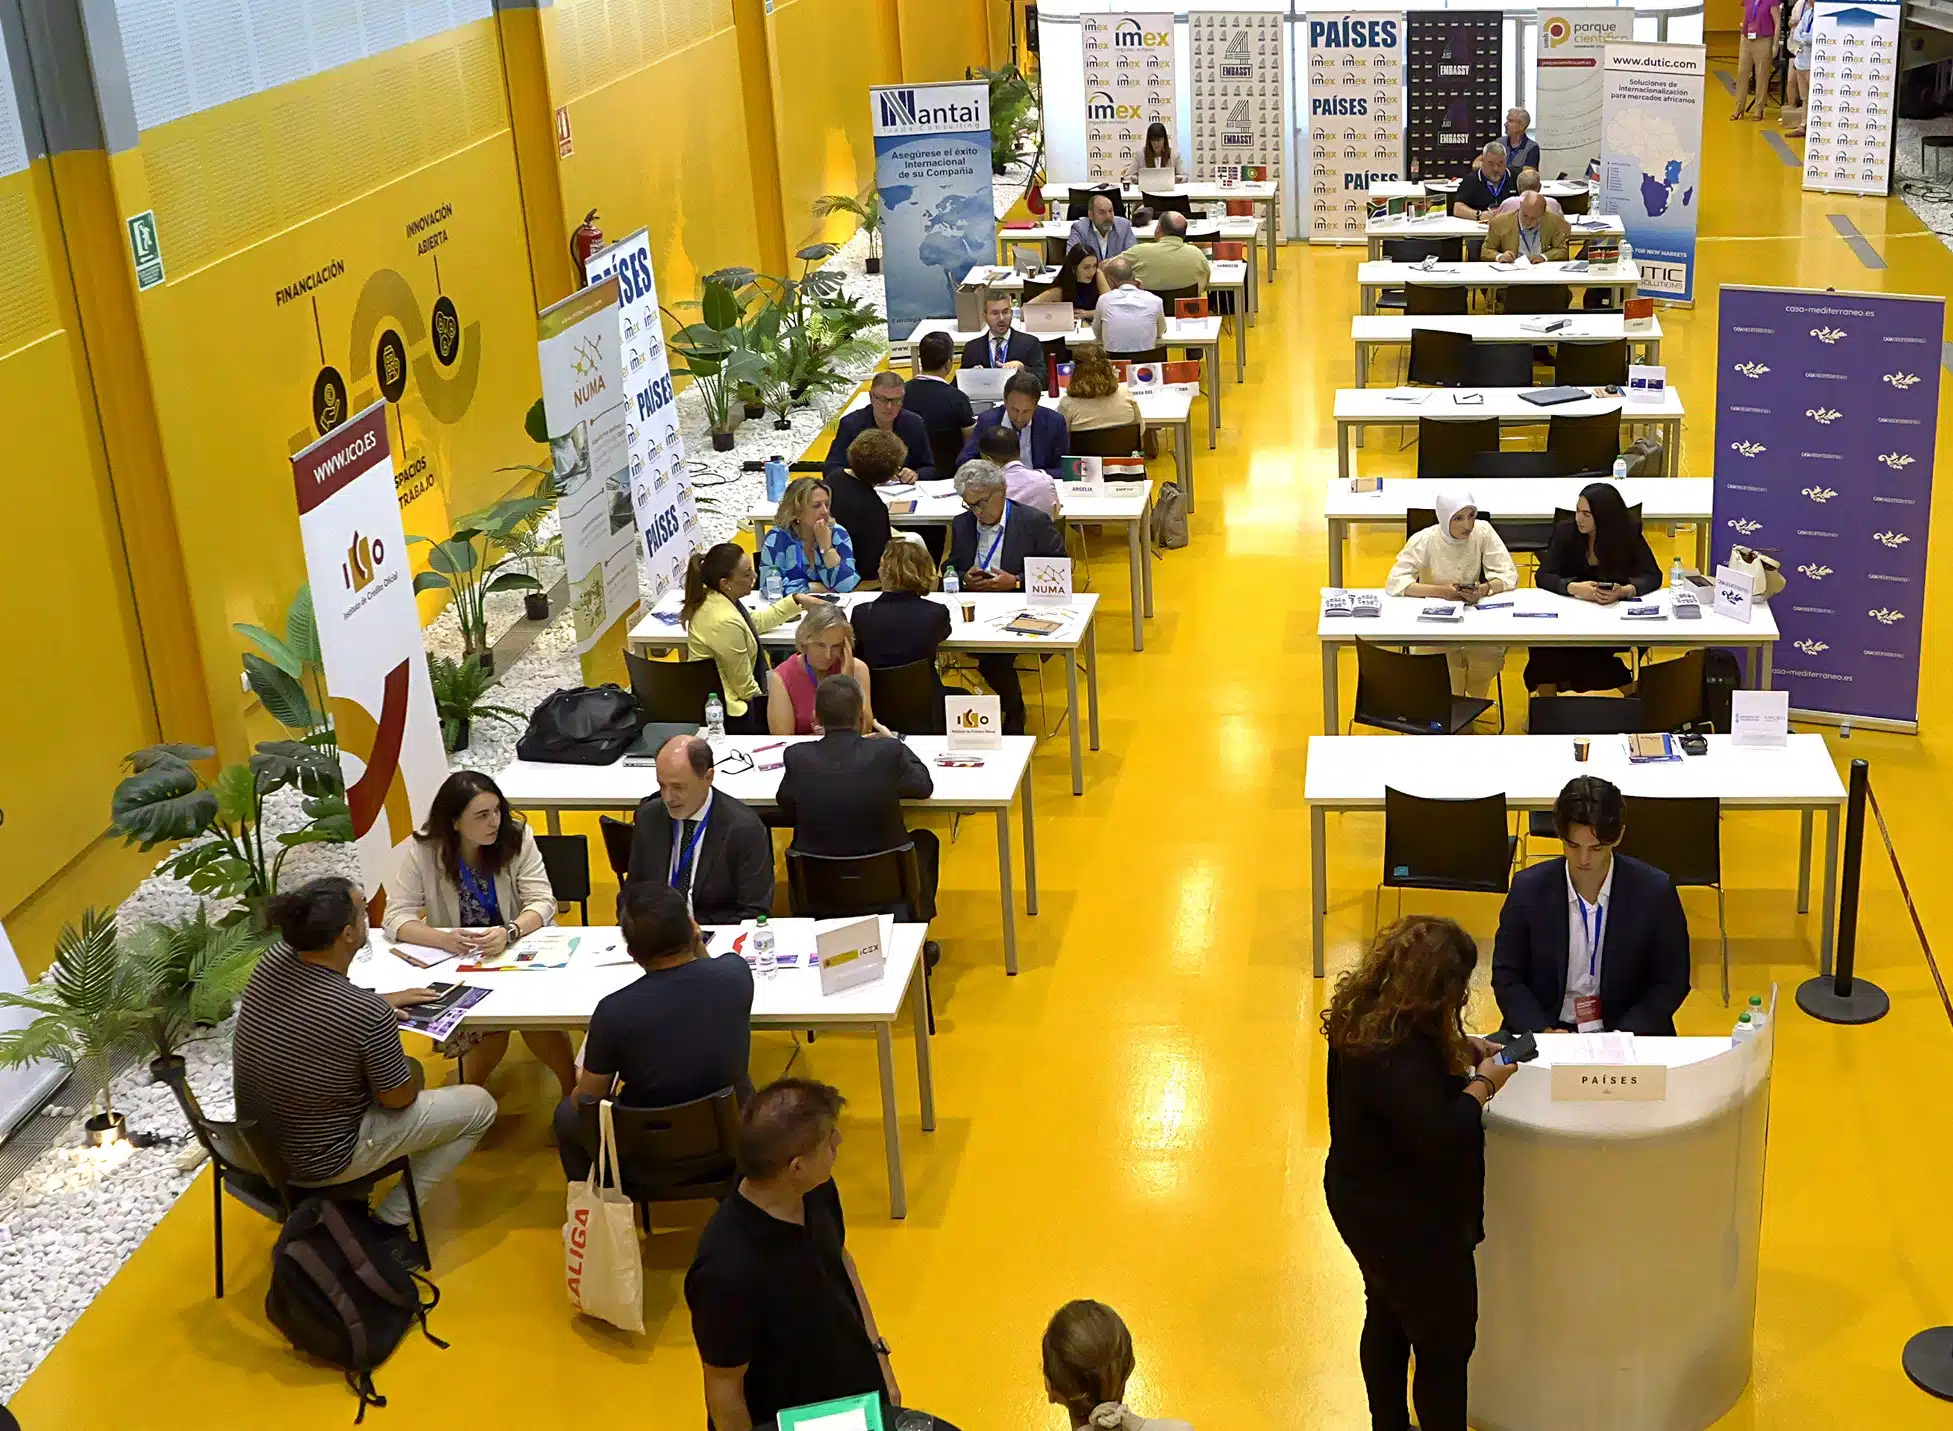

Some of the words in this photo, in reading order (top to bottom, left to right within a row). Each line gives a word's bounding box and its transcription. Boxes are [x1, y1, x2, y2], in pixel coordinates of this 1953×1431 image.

[1310, 16, 1397, 48] PAÍSES
[1574, 23, 1616, 33] parque
[1115, 25, 1169, 46] imex
[1613, 57, 1697, 69] www.dutic.com
[1222, 66, 1251, 76] EMBASSY
[1440, 65, 1469, 76] EMBASSY
[1629, 79, 1667, 87] Soluciones
[1618, 85, 1688, 95] internacionalización
[1628, 94, 1662, 102] mercados
[1663, 95, 1695, 104] africanos
[880, 90, 979, 126] Nantai
[1088, 98, 1141, 119] imex
[1312, 95, 1367, 116] PAÍSES
[1223, 135, 1252, 144] EMBASSY
[1440, 133, 1469, 144] EMBASSY
[944, 148, 952, 156] el
[955, 147, 978, 155] éxito
[905, 158, 966, 168] Internacional
[899, 170, 909, 179] de
[405, 202, 453, 238] INNOVACIÓN
[417, 230, 449, 257] ABIERTA
[275, 259, 345, 307] FINANCIACIÓN
[1785, 305, 1875, 317] casa-mediterraneo.es
[574, 375, 606, 408] NUMA
[637, 372, 673, 422] PAÍSES
[313, 430, 377, 484] WWW.ICO.ES
[399, 474, 435, 510] TRABAJO
[645, 504, 679, 558] PAÍSES
[1032, 585, 1065, 594] NUMA
[1772, 667, 1853, 682] asa-mediterraneo.es
[1582, 1075, 1638, 1085] PAÍSES
